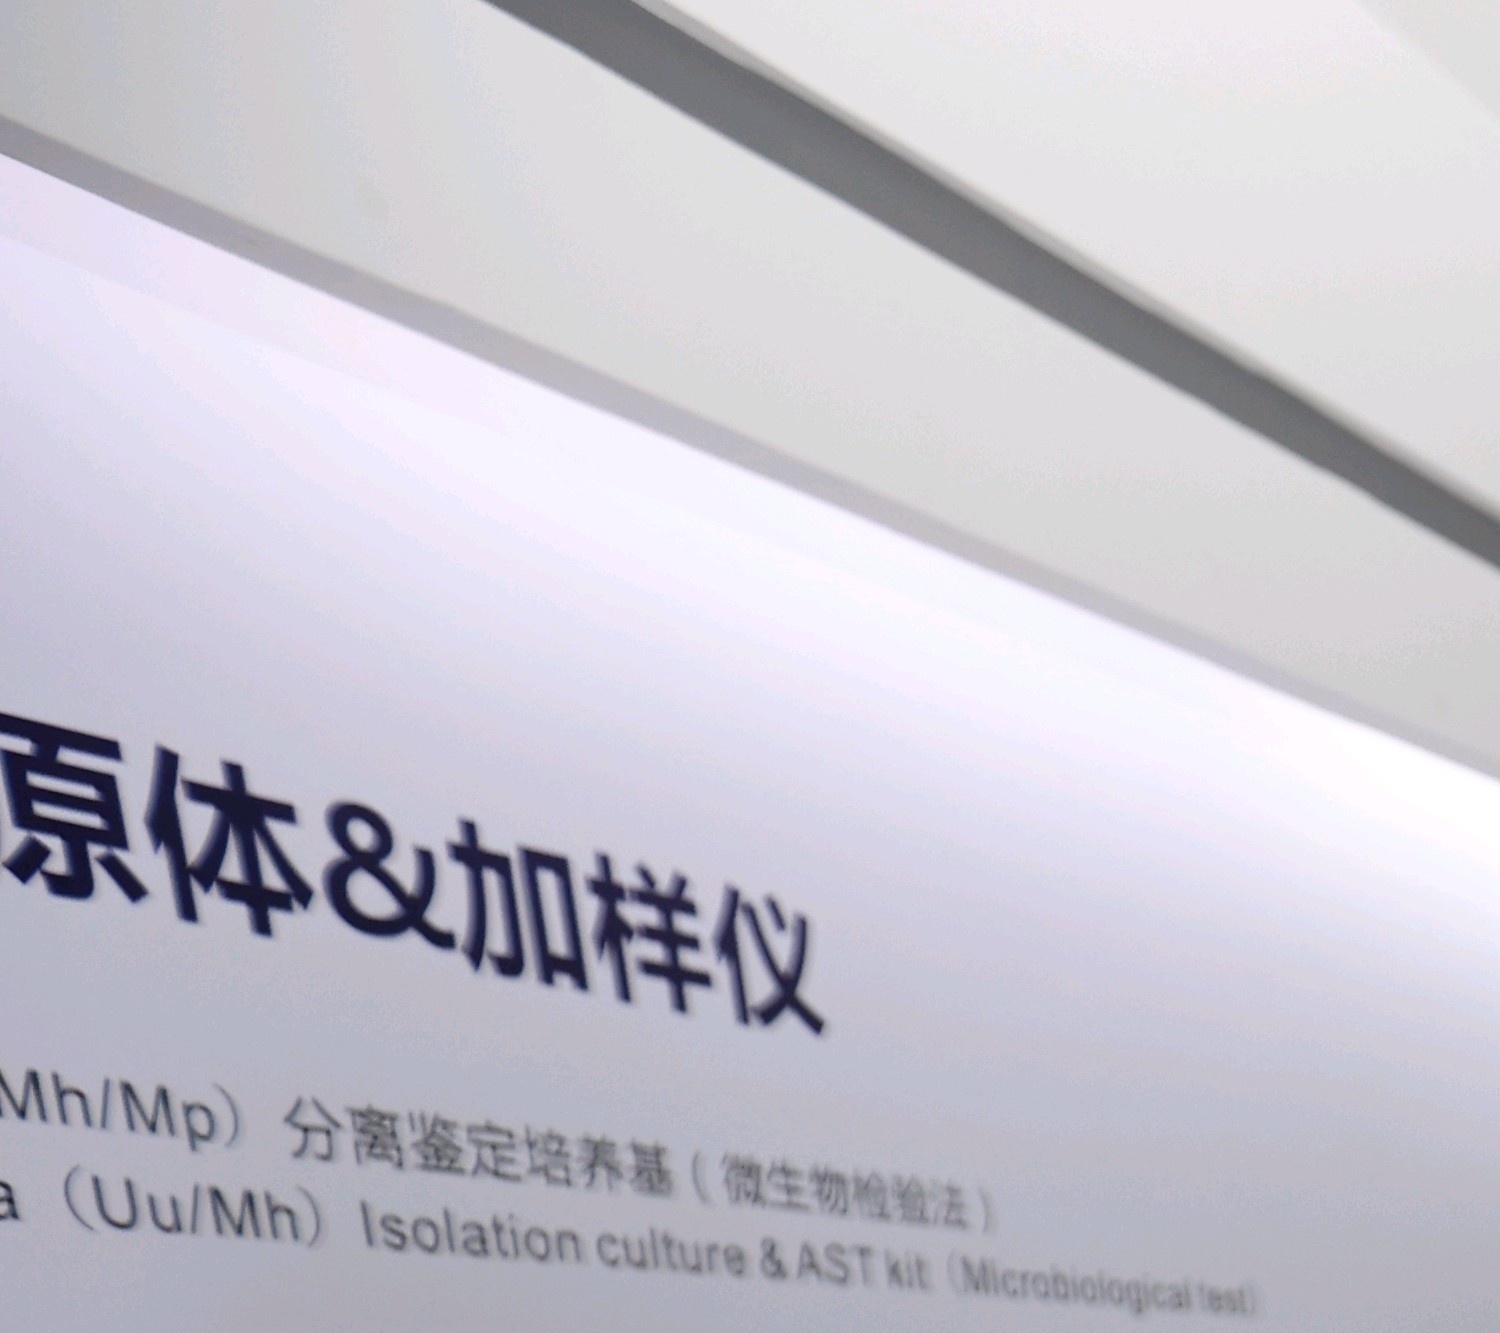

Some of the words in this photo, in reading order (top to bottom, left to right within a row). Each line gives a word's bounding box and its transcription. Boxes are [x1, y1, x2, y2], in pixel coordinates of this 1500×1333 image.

[0, 711, 824, 1034] 原体&加样仪
[360, 1203, 583, 1266] Isolation
[596, 1231, 748, 1279] culture
[759, 1237, 788, 1281] &
[796, 1243, 872, 1288] AST
[884, 1248, 930, 1292] kit
